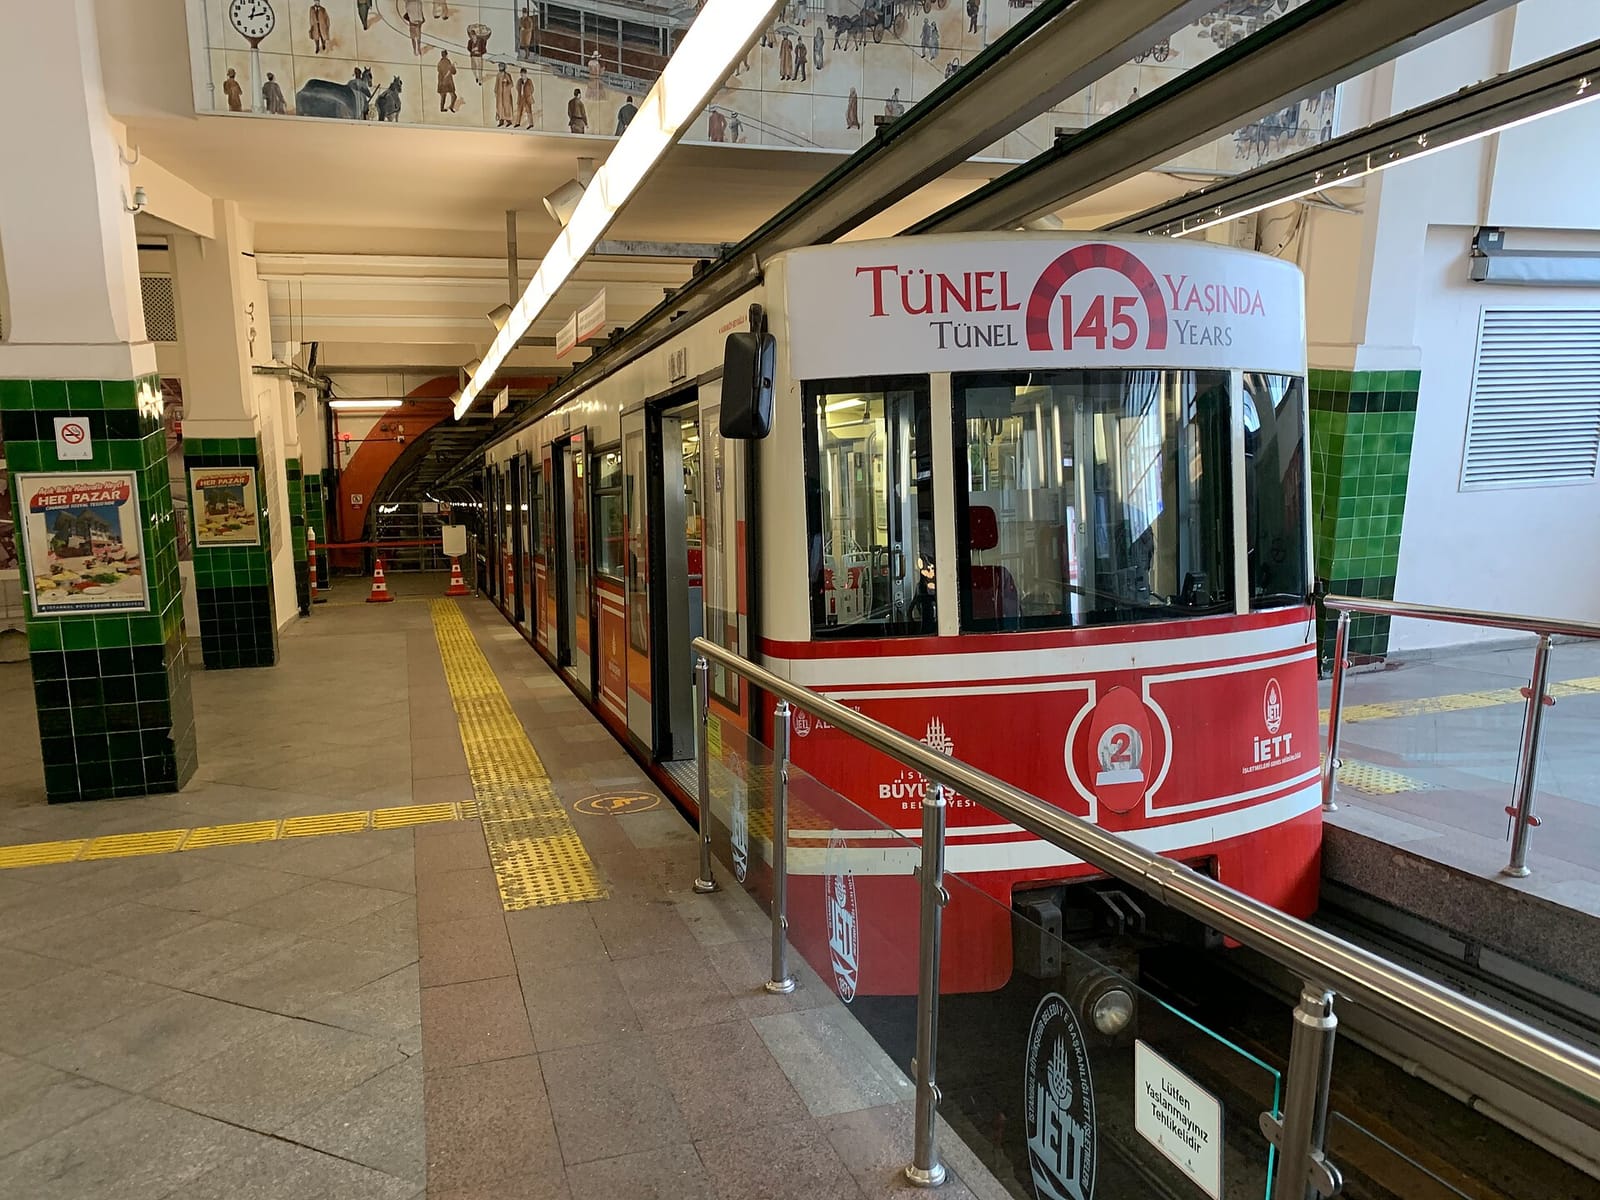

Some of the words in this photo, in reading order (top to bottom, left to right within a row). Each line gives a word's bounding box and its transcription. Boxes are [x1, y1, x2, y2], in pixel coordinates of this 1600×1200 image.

[856, 264, 1020, 318] TÜNEL
[1060, 294, 1138, 350] 145
[1162, 274, 1266, 317] YAŞINDA
[930, 320, 1018, 349] TÜNEL
[1173, 320, 1232, 347] YEARS
[38, 495, 66, 506] HER
[72, 490, 120, 503] PAZAR
[1110, 732, 1130, 762] 2
[1254, 733, 1292, 762] İETT
[1161, 1077, 1191, 1111] Lütfen
[1145, 1081, 1209, 1144] Yaslanmayınız
[1151, 1102, 1202, 1154] Tehlikelidir
